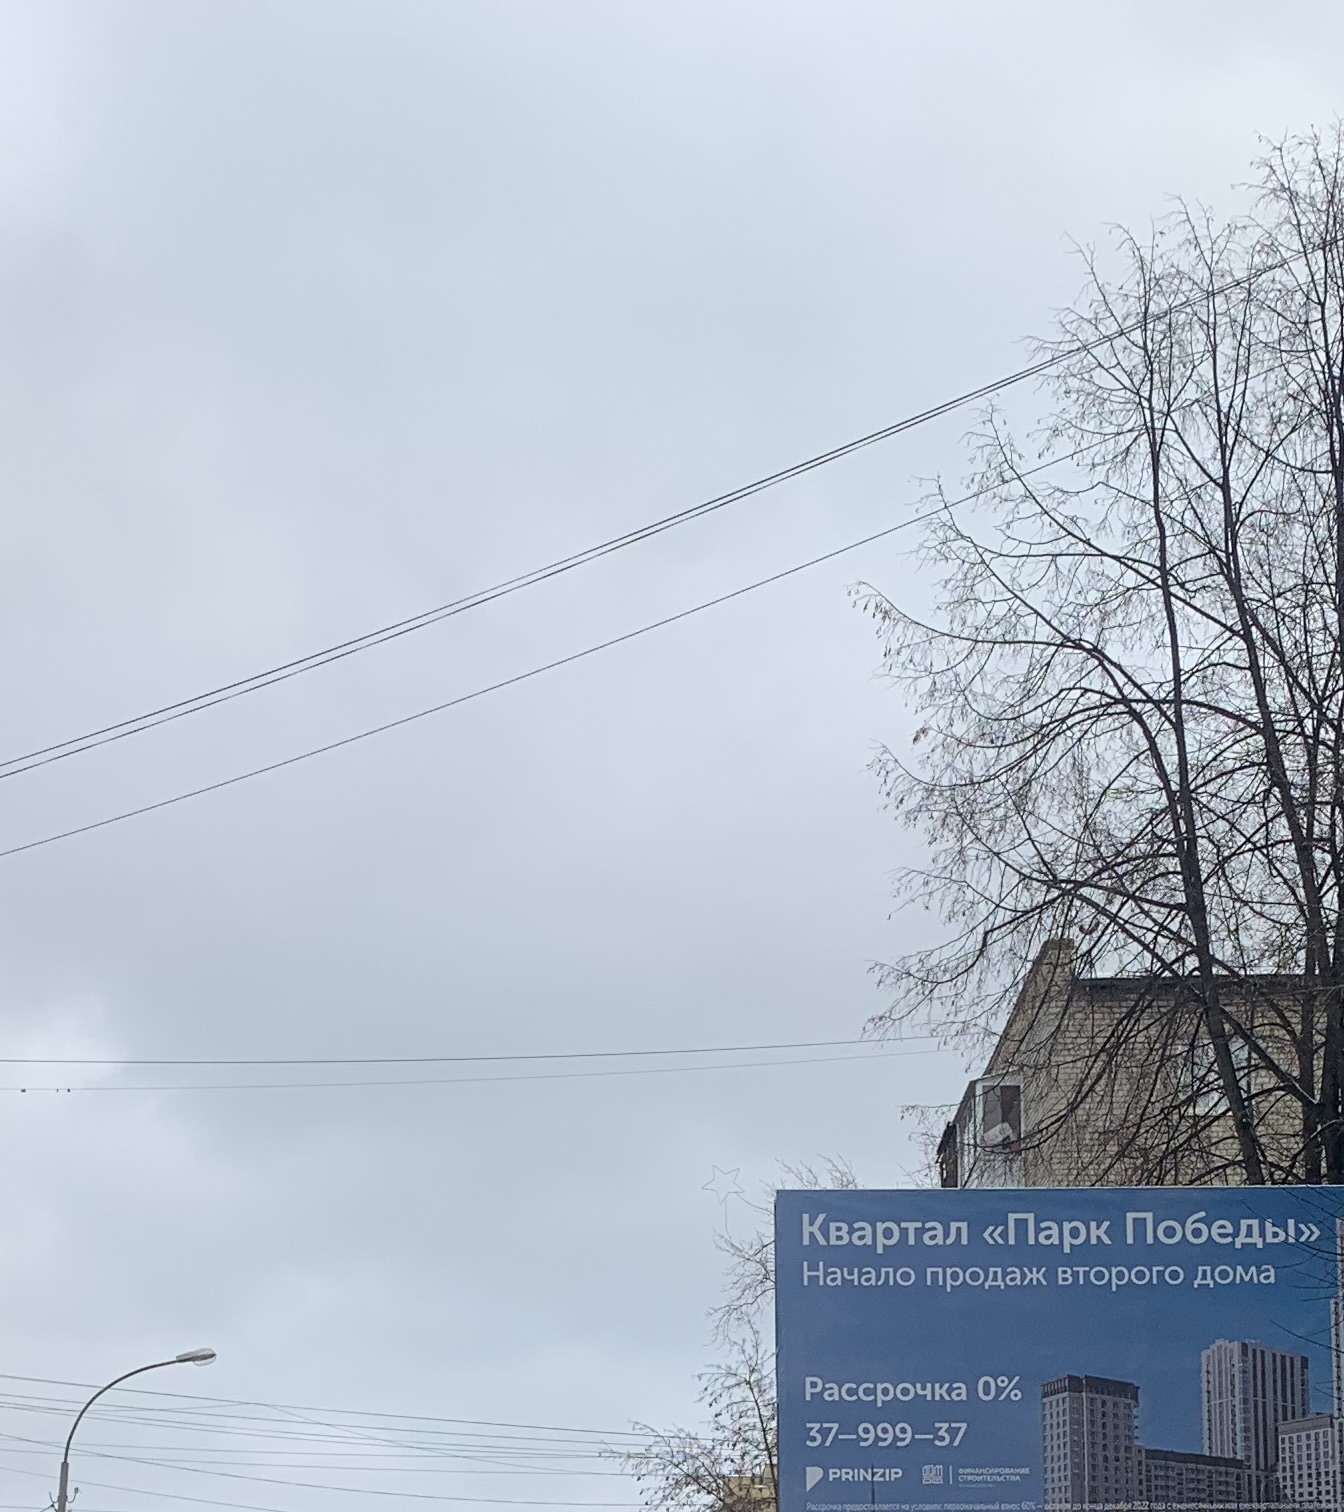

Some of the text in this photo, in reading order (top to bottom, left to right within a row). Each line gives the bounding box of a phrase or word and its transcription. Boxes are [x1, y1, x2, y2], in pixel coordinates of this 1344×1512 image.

[802, 1212, 1321, 1254] Квартал «Парк Победы»
[802, 1261, 1276, 1292] Начало продаж второго дома
[805, 1375, 1023, 1408] Рассрочка 0%
[828, 1468, 903, 1482] PRINZIP
[958, 1467, 1031, 1475] ФИНАНСИРОВАНИЕ
[1132, 1501, 1149, 1510] 2022
